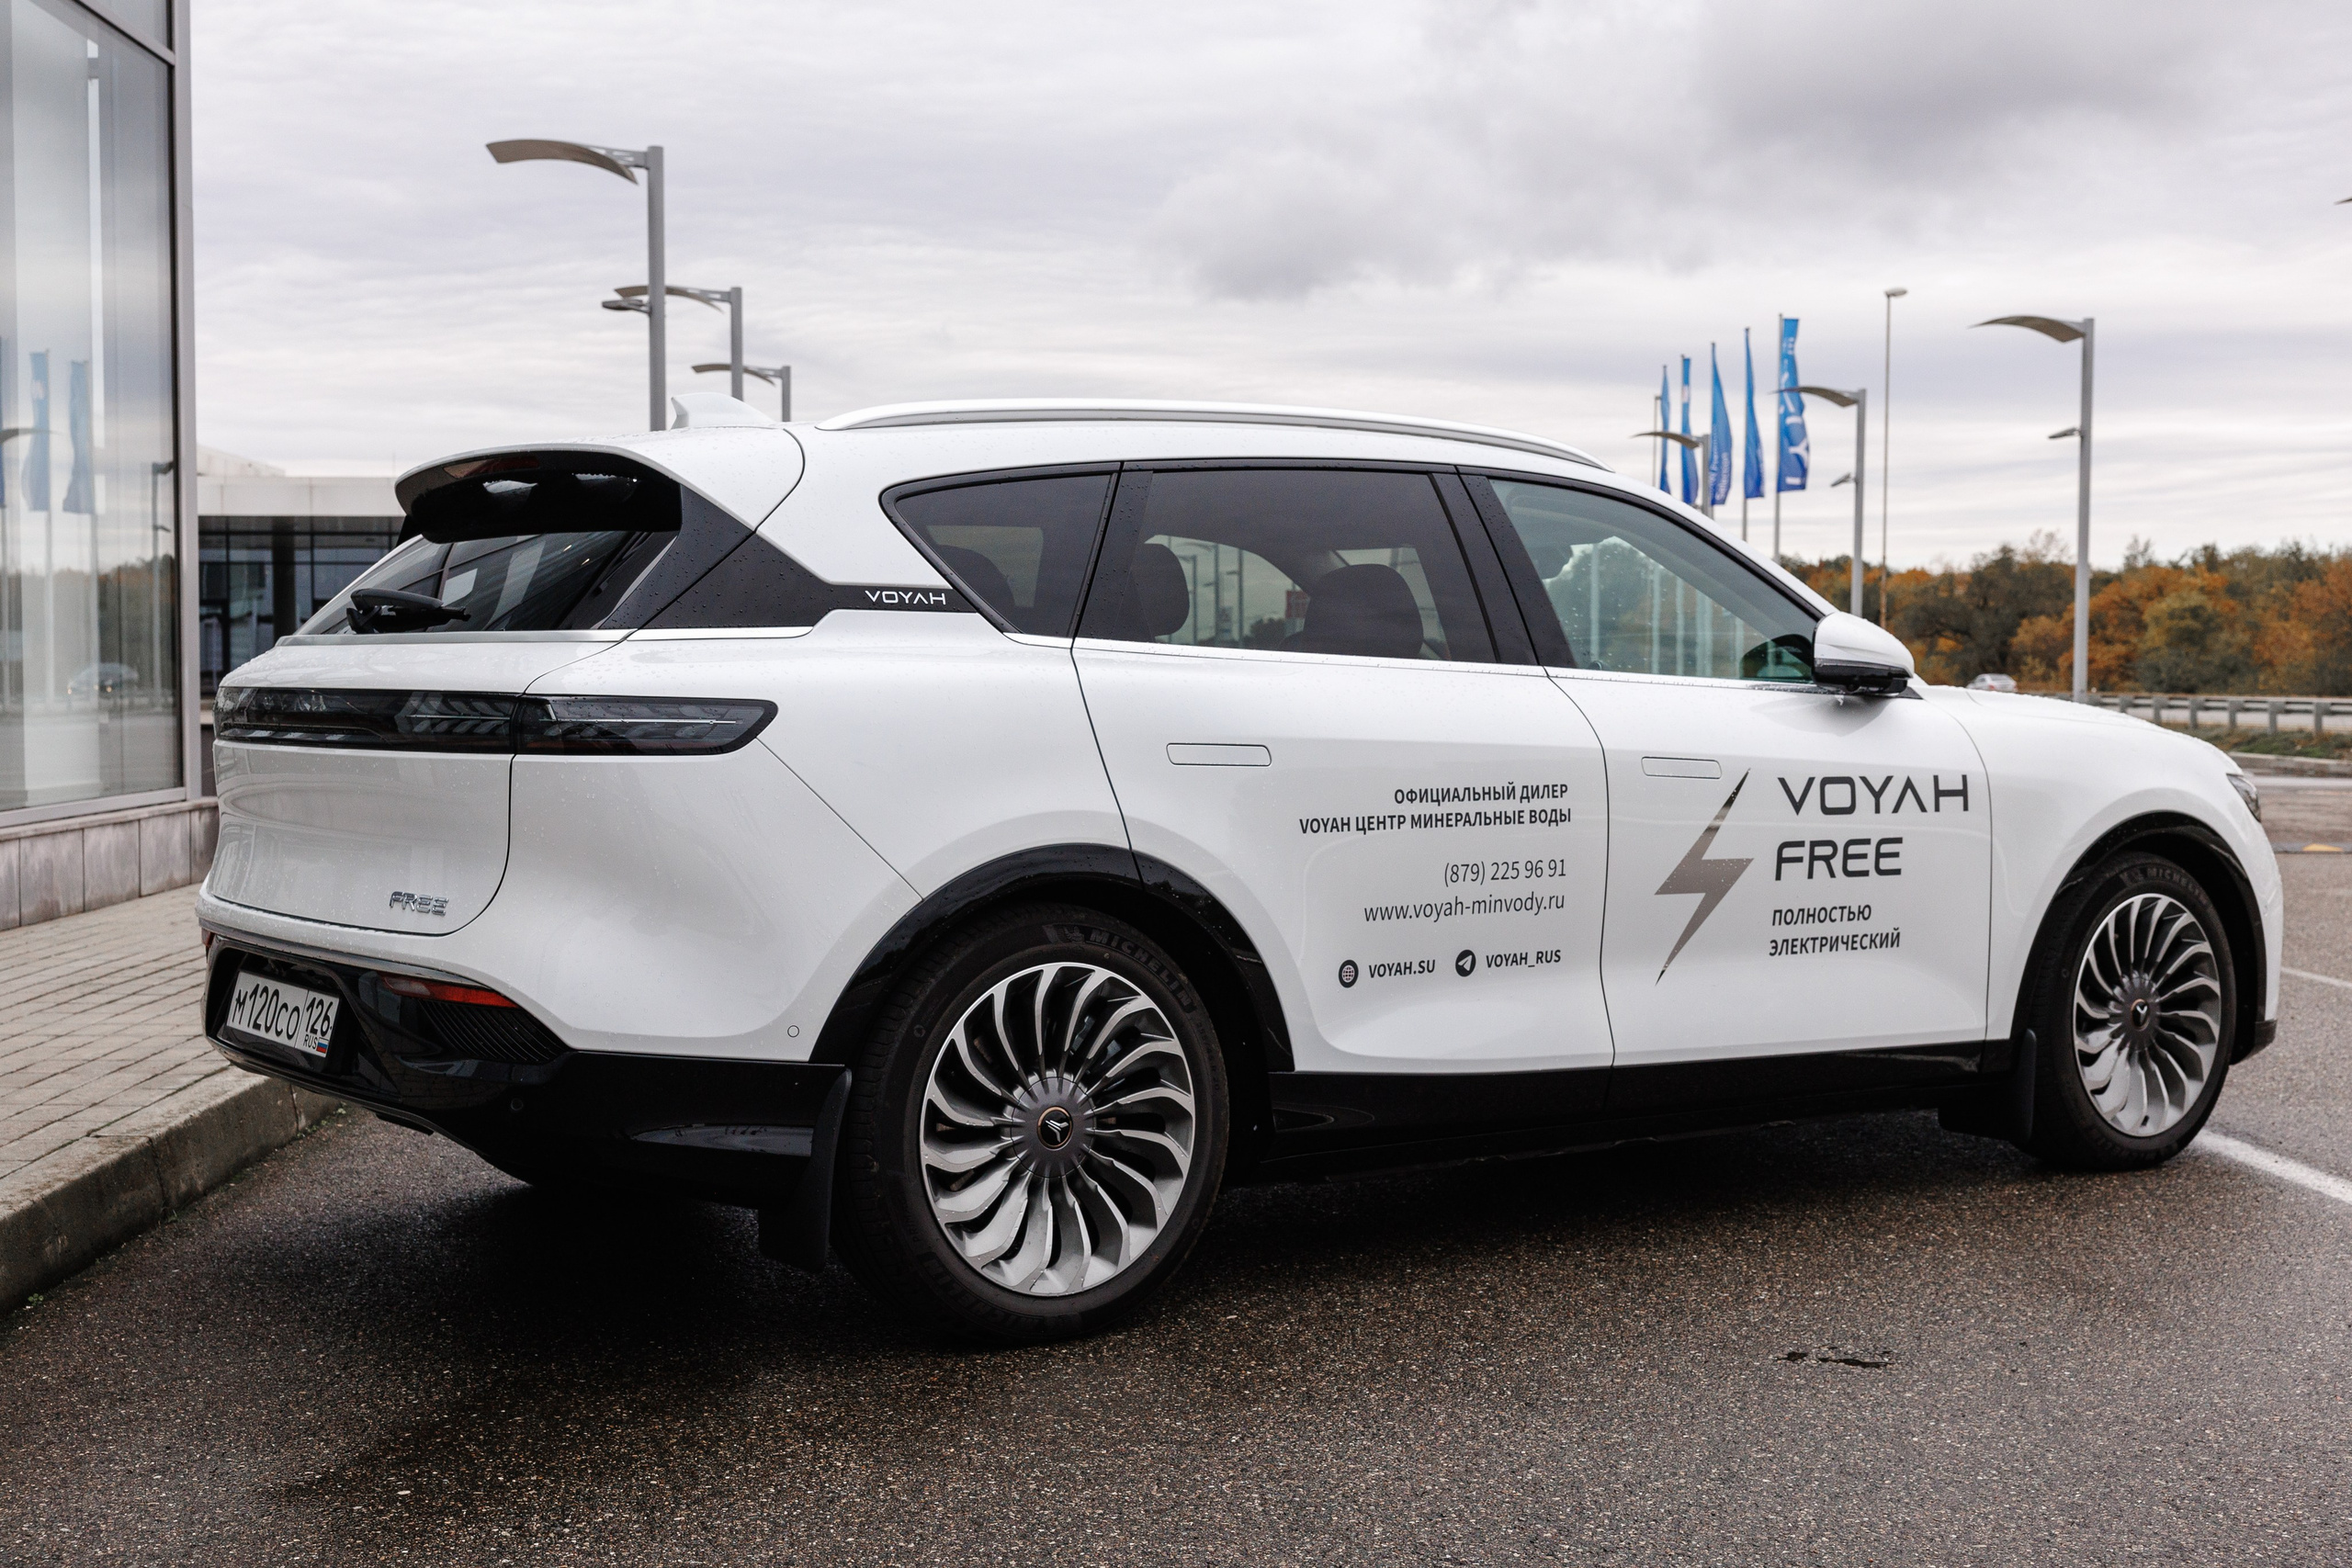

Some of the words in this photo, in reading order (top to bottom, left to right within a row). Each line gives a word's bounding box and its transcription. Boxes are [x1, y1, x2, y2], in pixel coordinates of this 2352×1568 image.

[865, 590, 946, 605] VOYAH
[1394, 781, 1516, 807] ОФИЦИАЛЬНЫЙ
[1519, 784, 1568, 804] ДИЛЕР
[1777, 774, 1969, 816] VOYAH
[1298, 817, 1351, 834] VOYAH
[1355, 814, 1407, 836] ЦЕНТР
[1410, 809, 1525, 829] МИНЕРАЛЬНЫЕ
[1529, 807, 1571, 828] ВОДЫ
[1444, 861, 1486, 888] (879)
[1490, 861, 1520, 881] 225
[1524, 859, 1544, 879] 96
[1548, 858, 1566, 878] 91
[1774, 836, 1904, 882] FREE
[389, 890, 450, 917] FREE
[1363, 890, 1565, 923] www.voyah-minvody.ru
[1771, 904, 1872, 927] ПОЛНОСТЬЮ
[1769, 927, 1901, 957] ЭЛЕКТРИЧЕСКИЙ
[1090, 928, 1193, 1008] MICHELIN
[1368, 959, 1436, 979] VOYAH.SU
[1486, 949, 1562, 969] VOYAH_RUS
[306, 997, 334, 1037] 126
[303, 1033, 319, 1050] RUS
